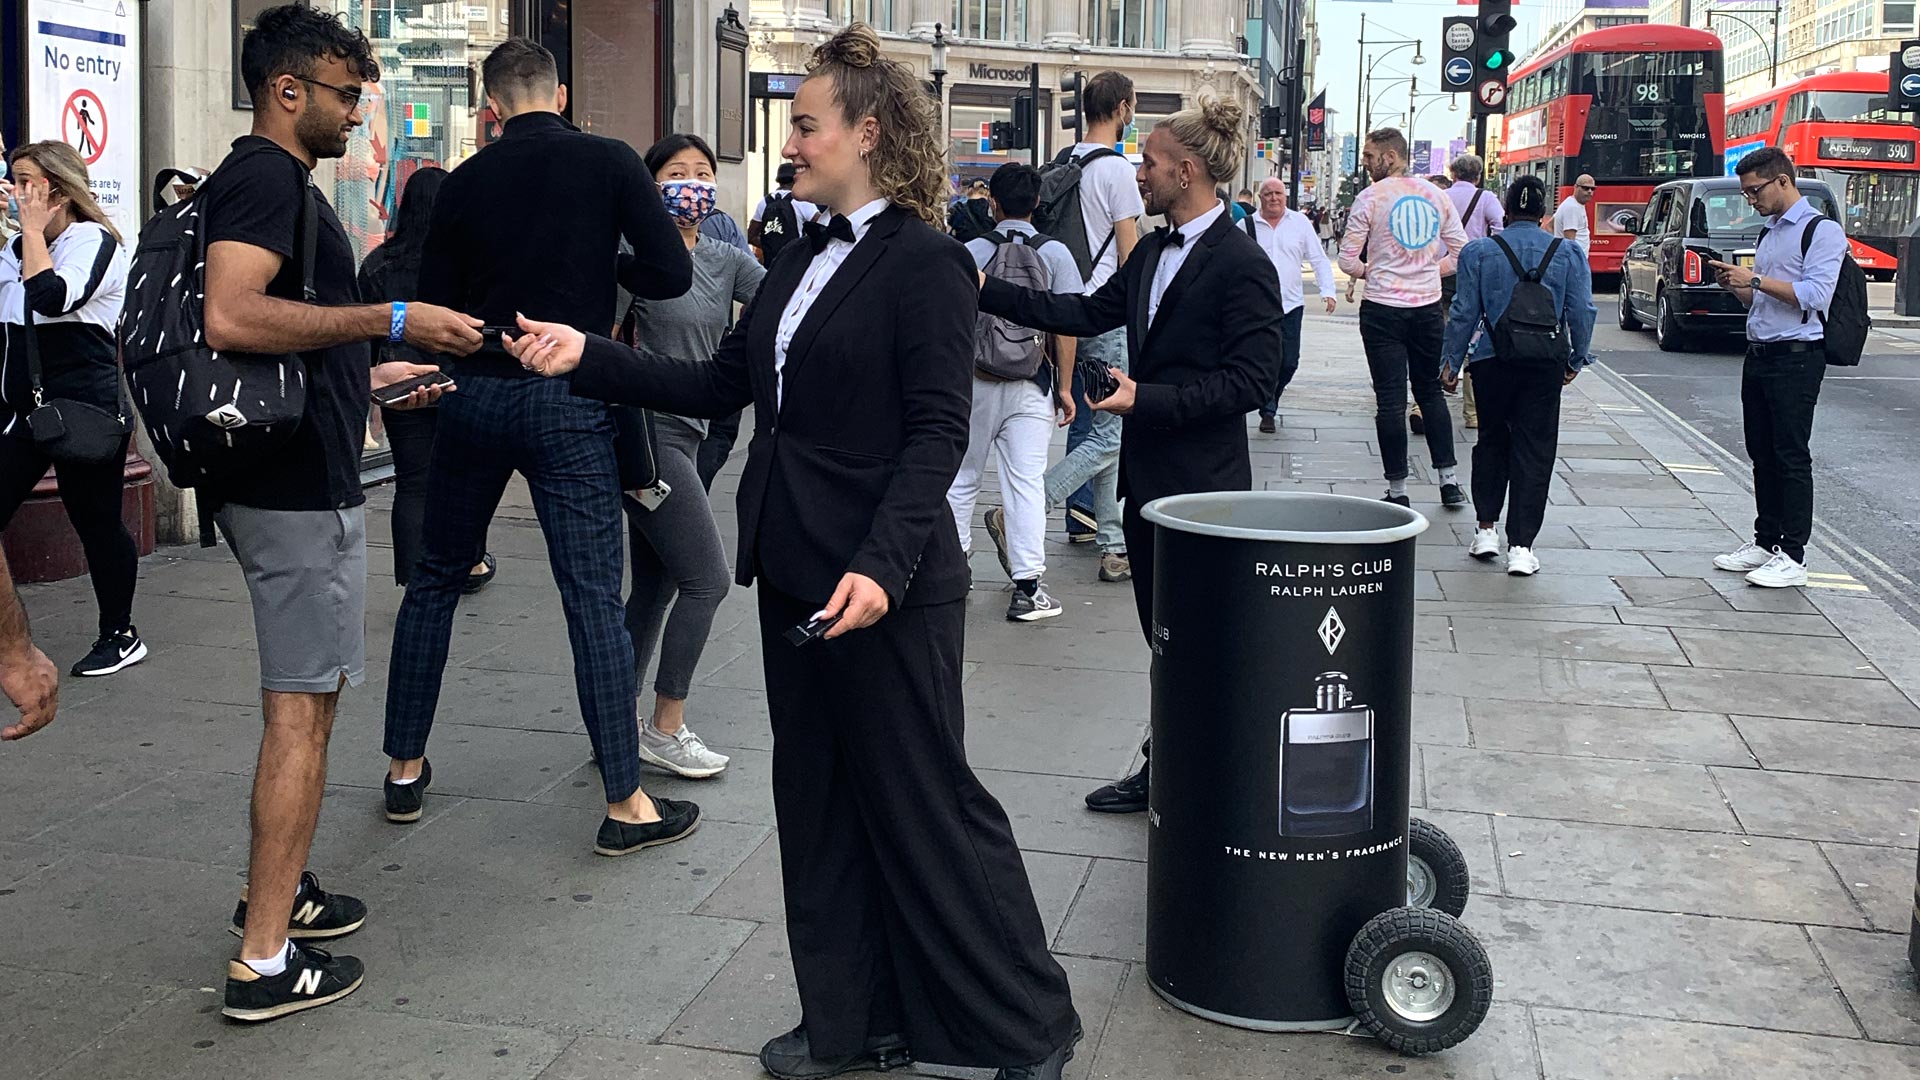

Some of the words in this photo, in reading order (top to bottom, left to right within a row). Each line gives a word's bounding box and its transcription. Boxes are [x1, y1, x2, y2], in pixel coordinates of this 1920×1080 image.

[44, 45, 70, 70] No
[75, 55, 121, 82] entry
[969, 63, 1031, 81] Microsof
[1636, 84, 1659, 101] 98
[1828, 142, 1872, 155] Archway
[1887, 144, 1908, 158] 390
[101, 193, 119, 204] H&M
[1351, 558, 1393, 576] CLUB
[1270, 585, 1324, 597] RALPH
[1330, 581, 1384, 597] LAUREN
[1224, 846, 1251, 858] THE
[1258, 851, 1288, 861] NEW
[1295, 850, 1340, 861] MEN'S
[1345, 835, 1403, 858] FRAGRANCE
